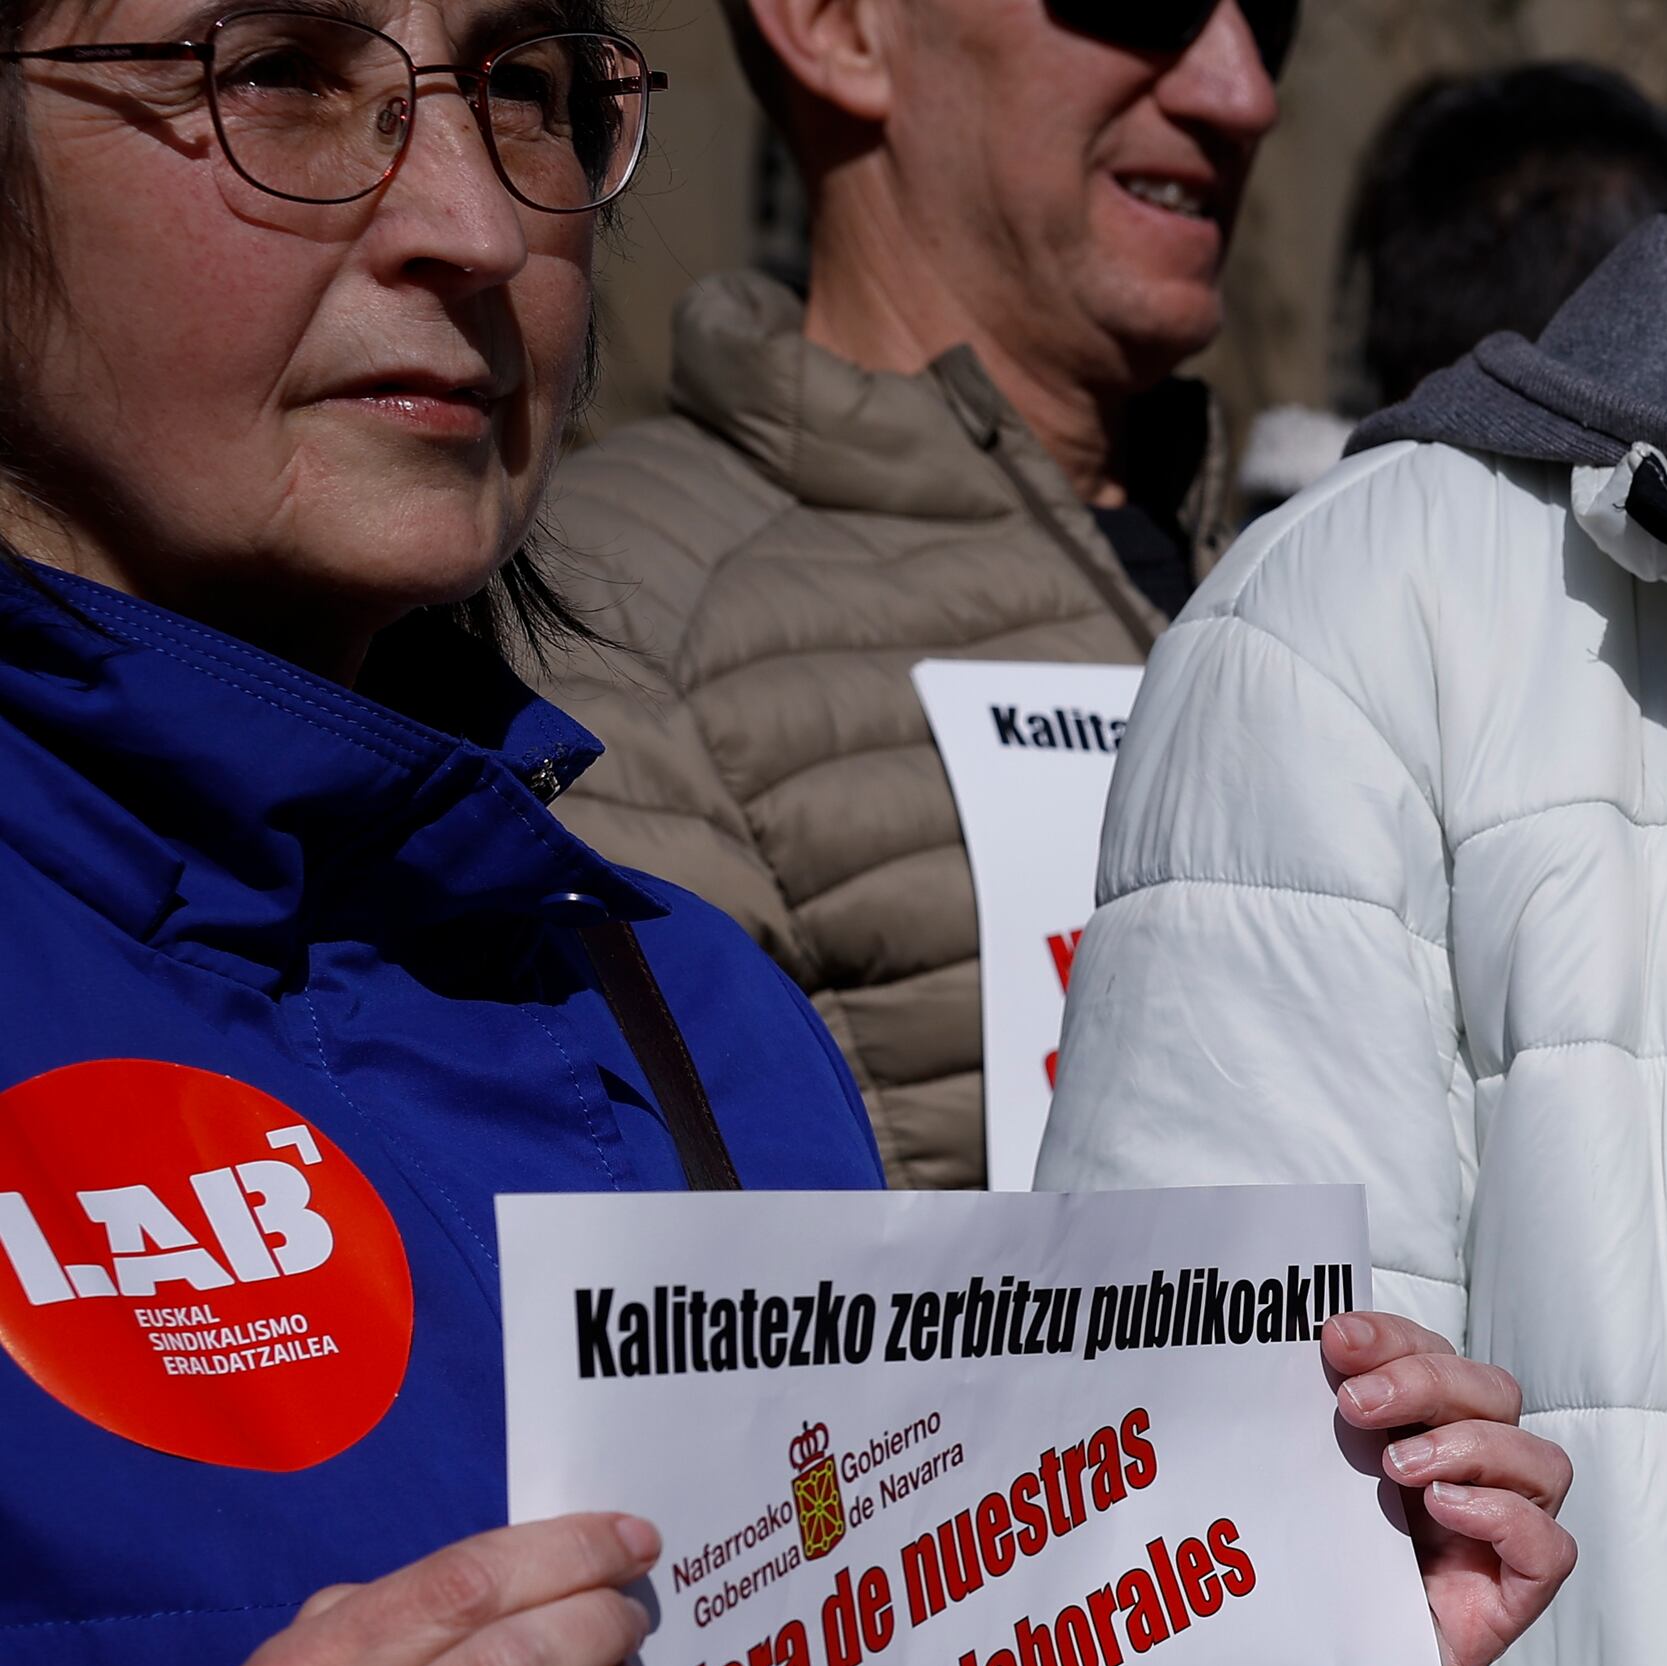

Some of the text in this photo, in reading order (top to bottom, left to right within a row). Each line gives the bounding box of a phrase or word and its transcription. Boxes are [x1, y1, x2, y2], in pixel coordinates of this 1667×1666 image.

[0, 1125, 333, 1306] LAB
[134, 1303, 221, 1330] EUSKAL
[148, 1313, 309, 1353] SINDIKALISMO
[162, 1336, 340, 1377] ERALDATZAILEA
[575, 1280, 876, 1379] Kalitatezko
[884, 1275, 1082, 1363] zerbitzu
[840, 1410, 942, 1484] Gobierno
[849, 1442, 965, 1530] de Navarra
[671, 1499, 793, 1594] Nafarroako
[900, 1407, 1158, 1628] nuestras
[693, 1545, 800, 1628] Gobernua
